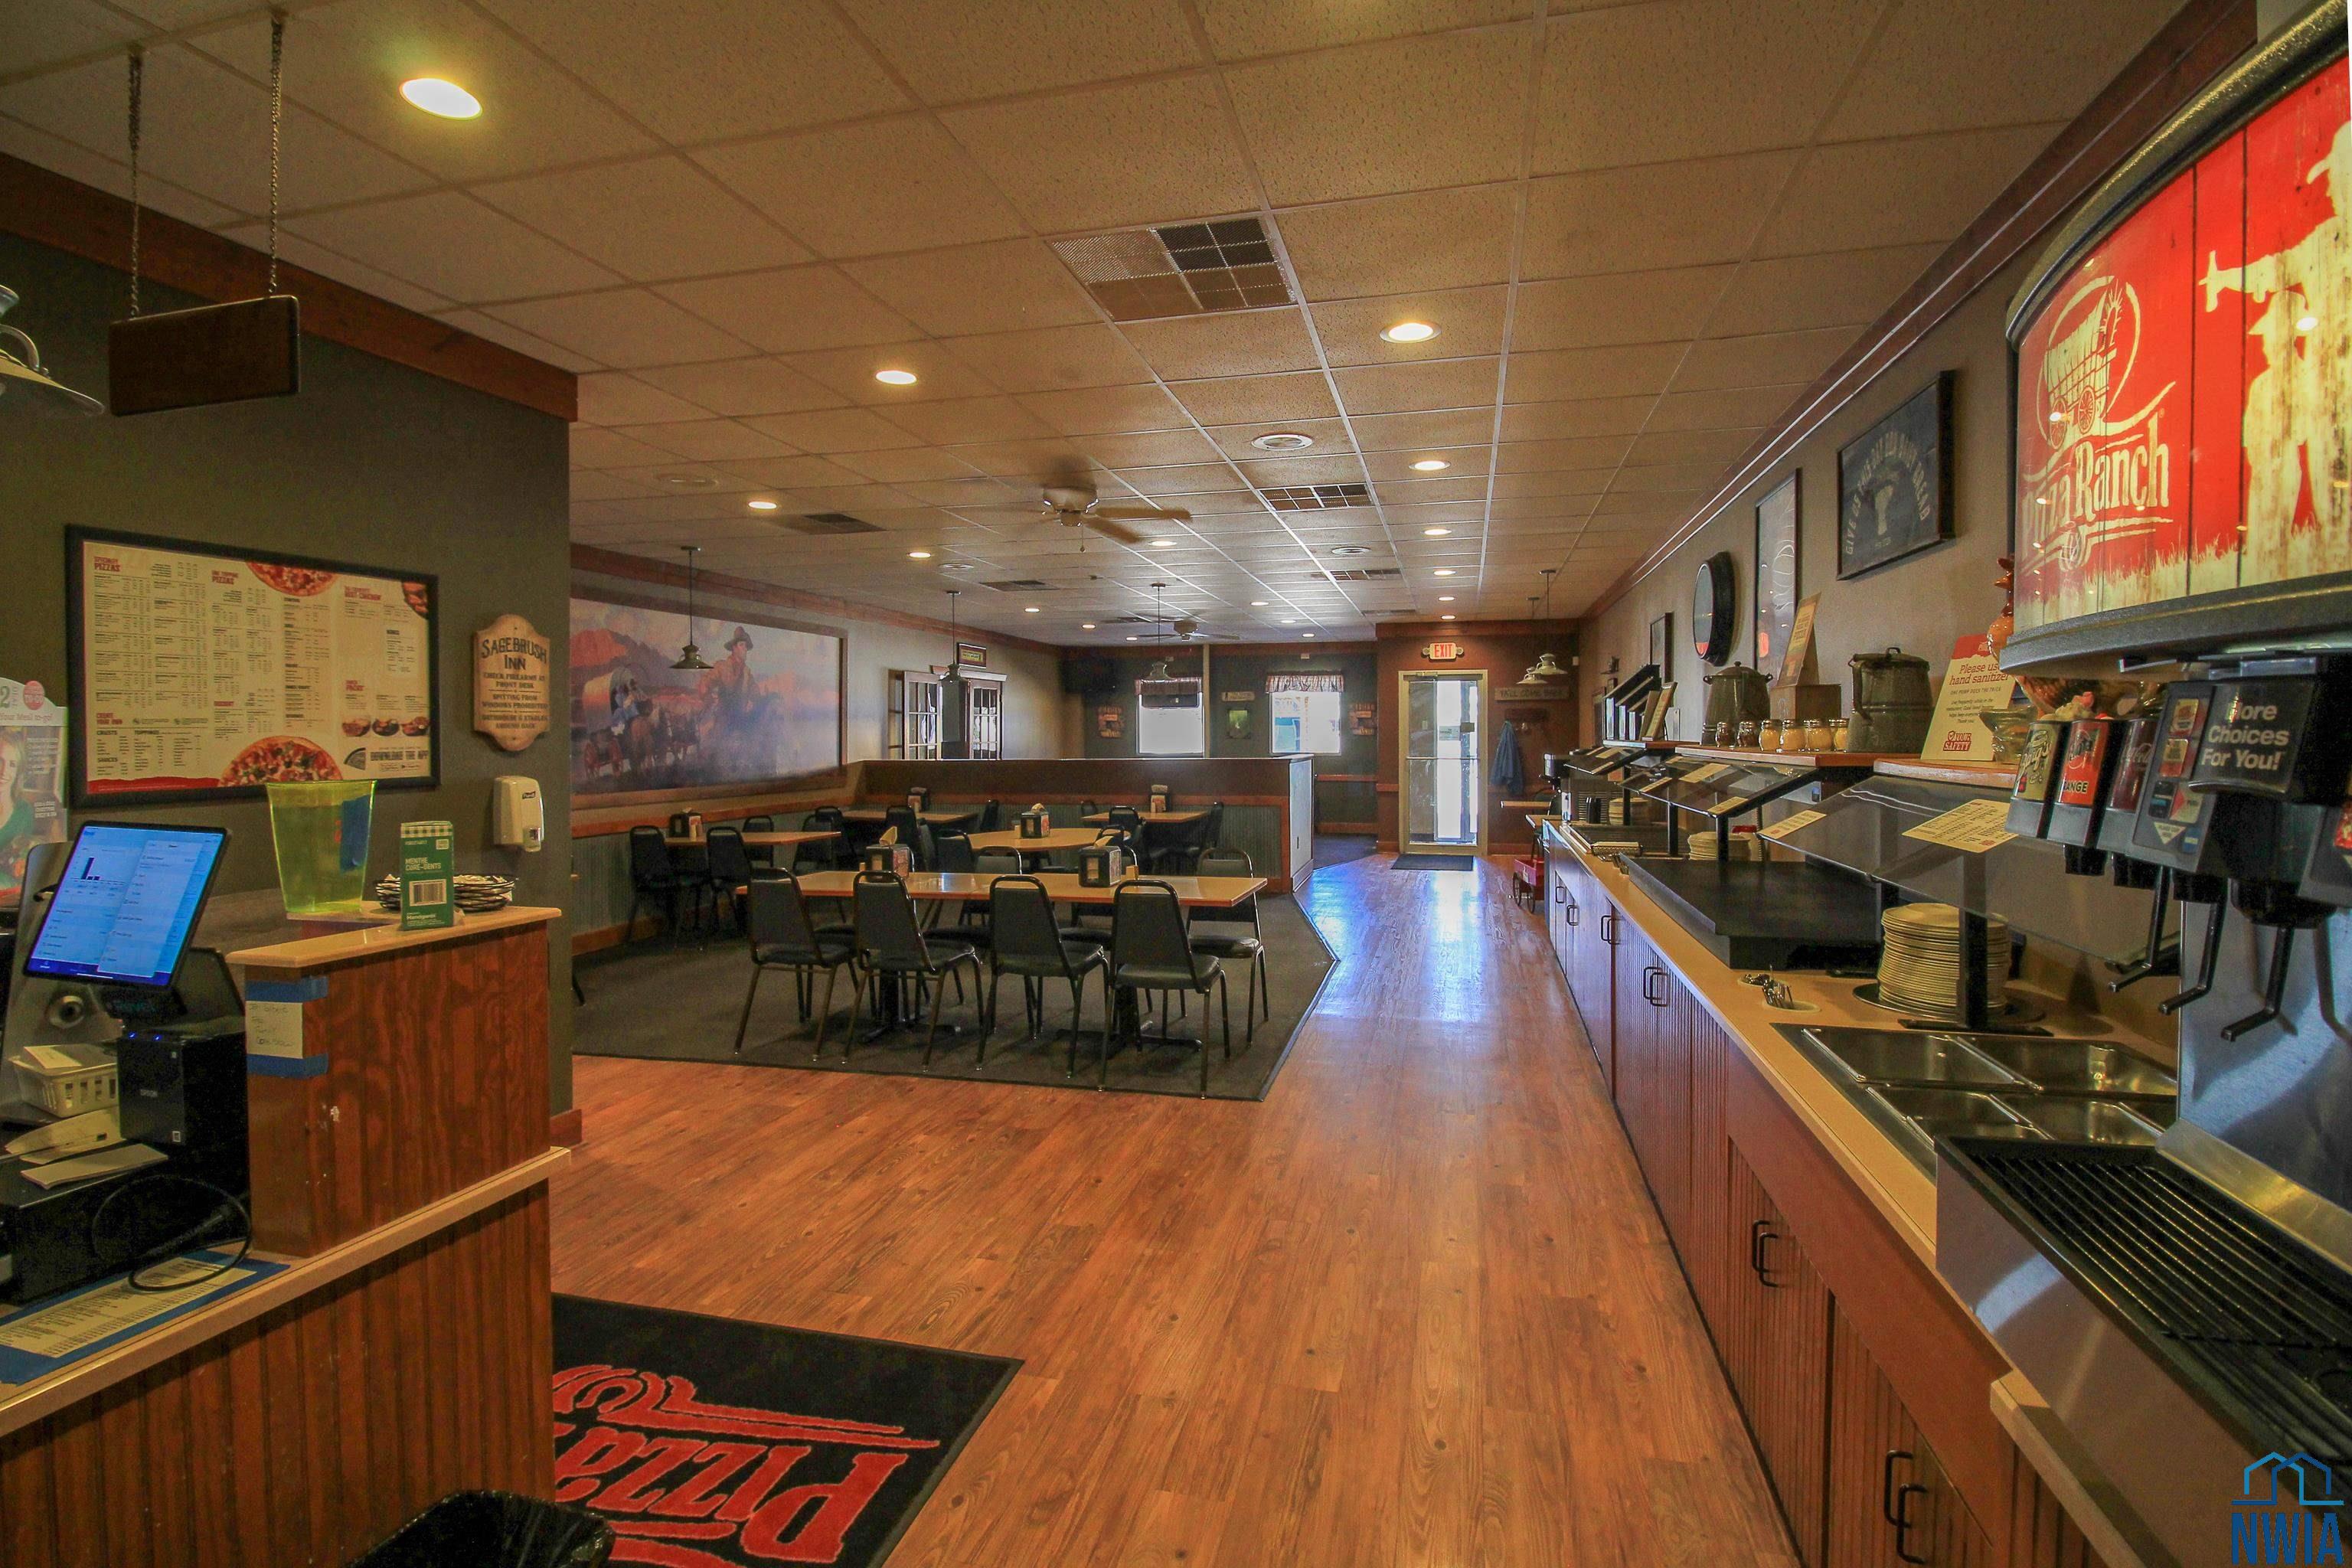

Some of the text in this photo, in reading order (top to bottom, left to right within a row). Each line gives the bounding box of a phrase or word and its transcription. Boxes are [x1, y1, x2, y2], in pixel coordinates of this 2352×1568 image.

[2021, 410, 2170, 563] Pizza Ranch
[1846, 519, 1857, 555] GIVE
[93, 562, 121, 573] PIZZAS
[211, 576, 235, 586] PIZZAS
[481, 636, 547, 665] SAGEBRUSH
[1434, 644, 1453, 658] EXIT
[504, 654, 527, 671] INN
[1958, 663, 1986, 675] Please
[1949, 671, 2009, 686] hand sanitizer
[2207, 724, 2291, 746] Choices
[2200, 748, 2282, 770] For You!
[2063, 781, 2089, 793] ANGE
[405, 857, 428, 865] MENTHE
[553, 1426, 908, 1563] Pizza
